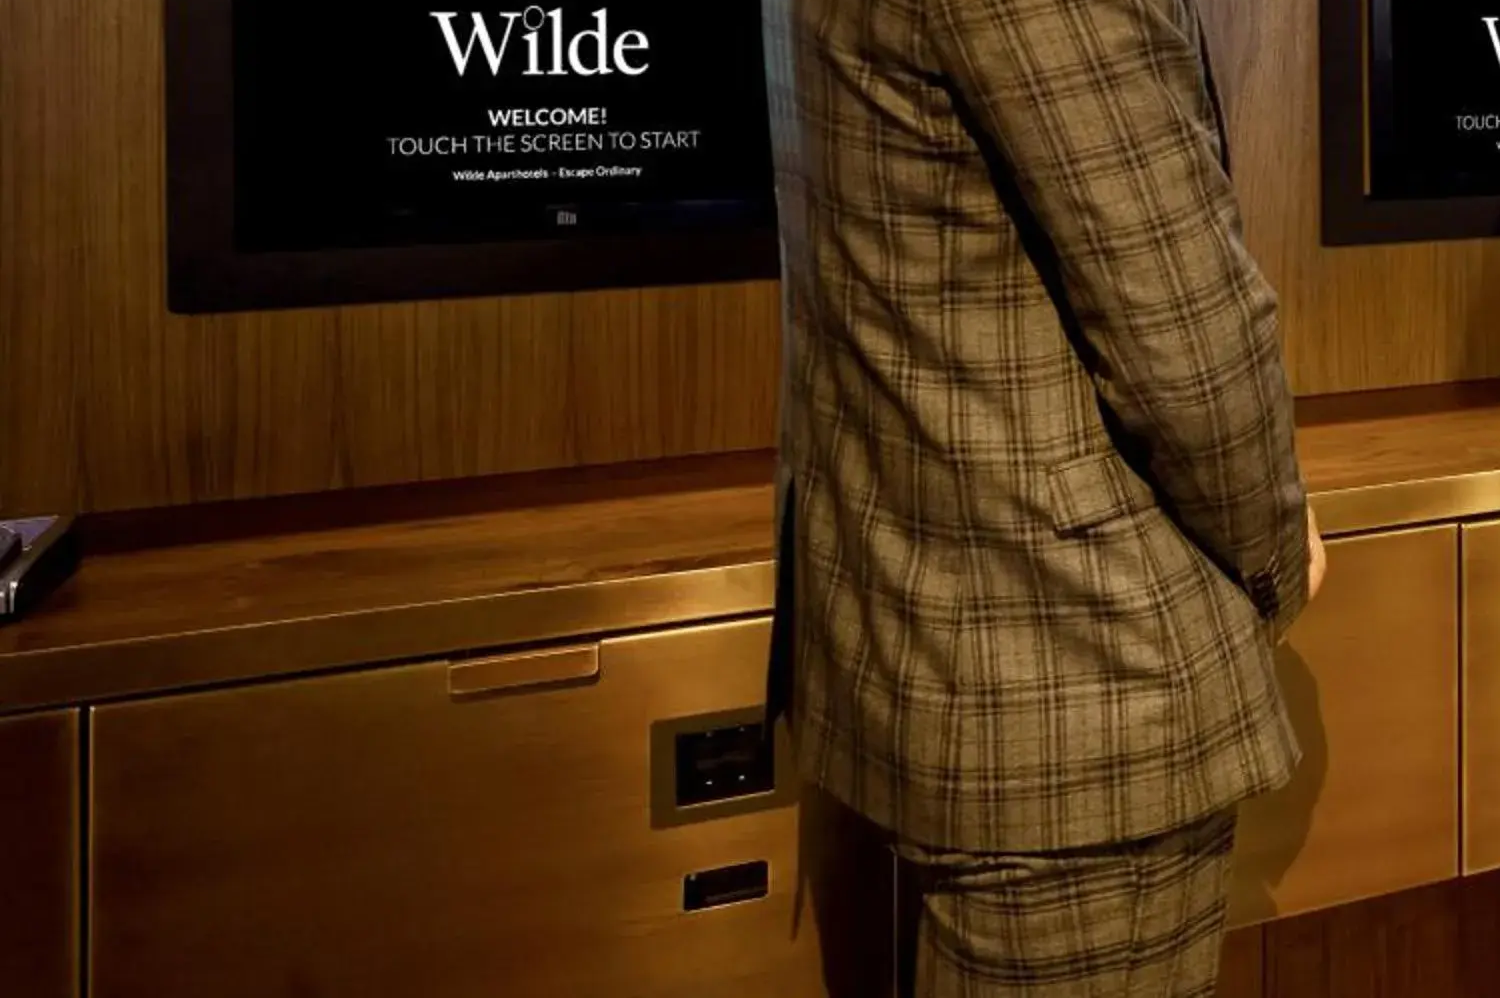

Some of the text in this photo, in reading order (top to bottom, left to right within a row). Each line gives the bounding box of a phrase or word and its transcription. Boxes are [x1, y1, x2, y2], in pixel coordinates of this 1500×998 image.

[429, 5, 650, 77] Wilde
[487, 107, 607, 127] WELCOME!
[387, 130, 700, 156] TOUCH THE SCREEN TO START
[558, 167, 594, 179] Escape
